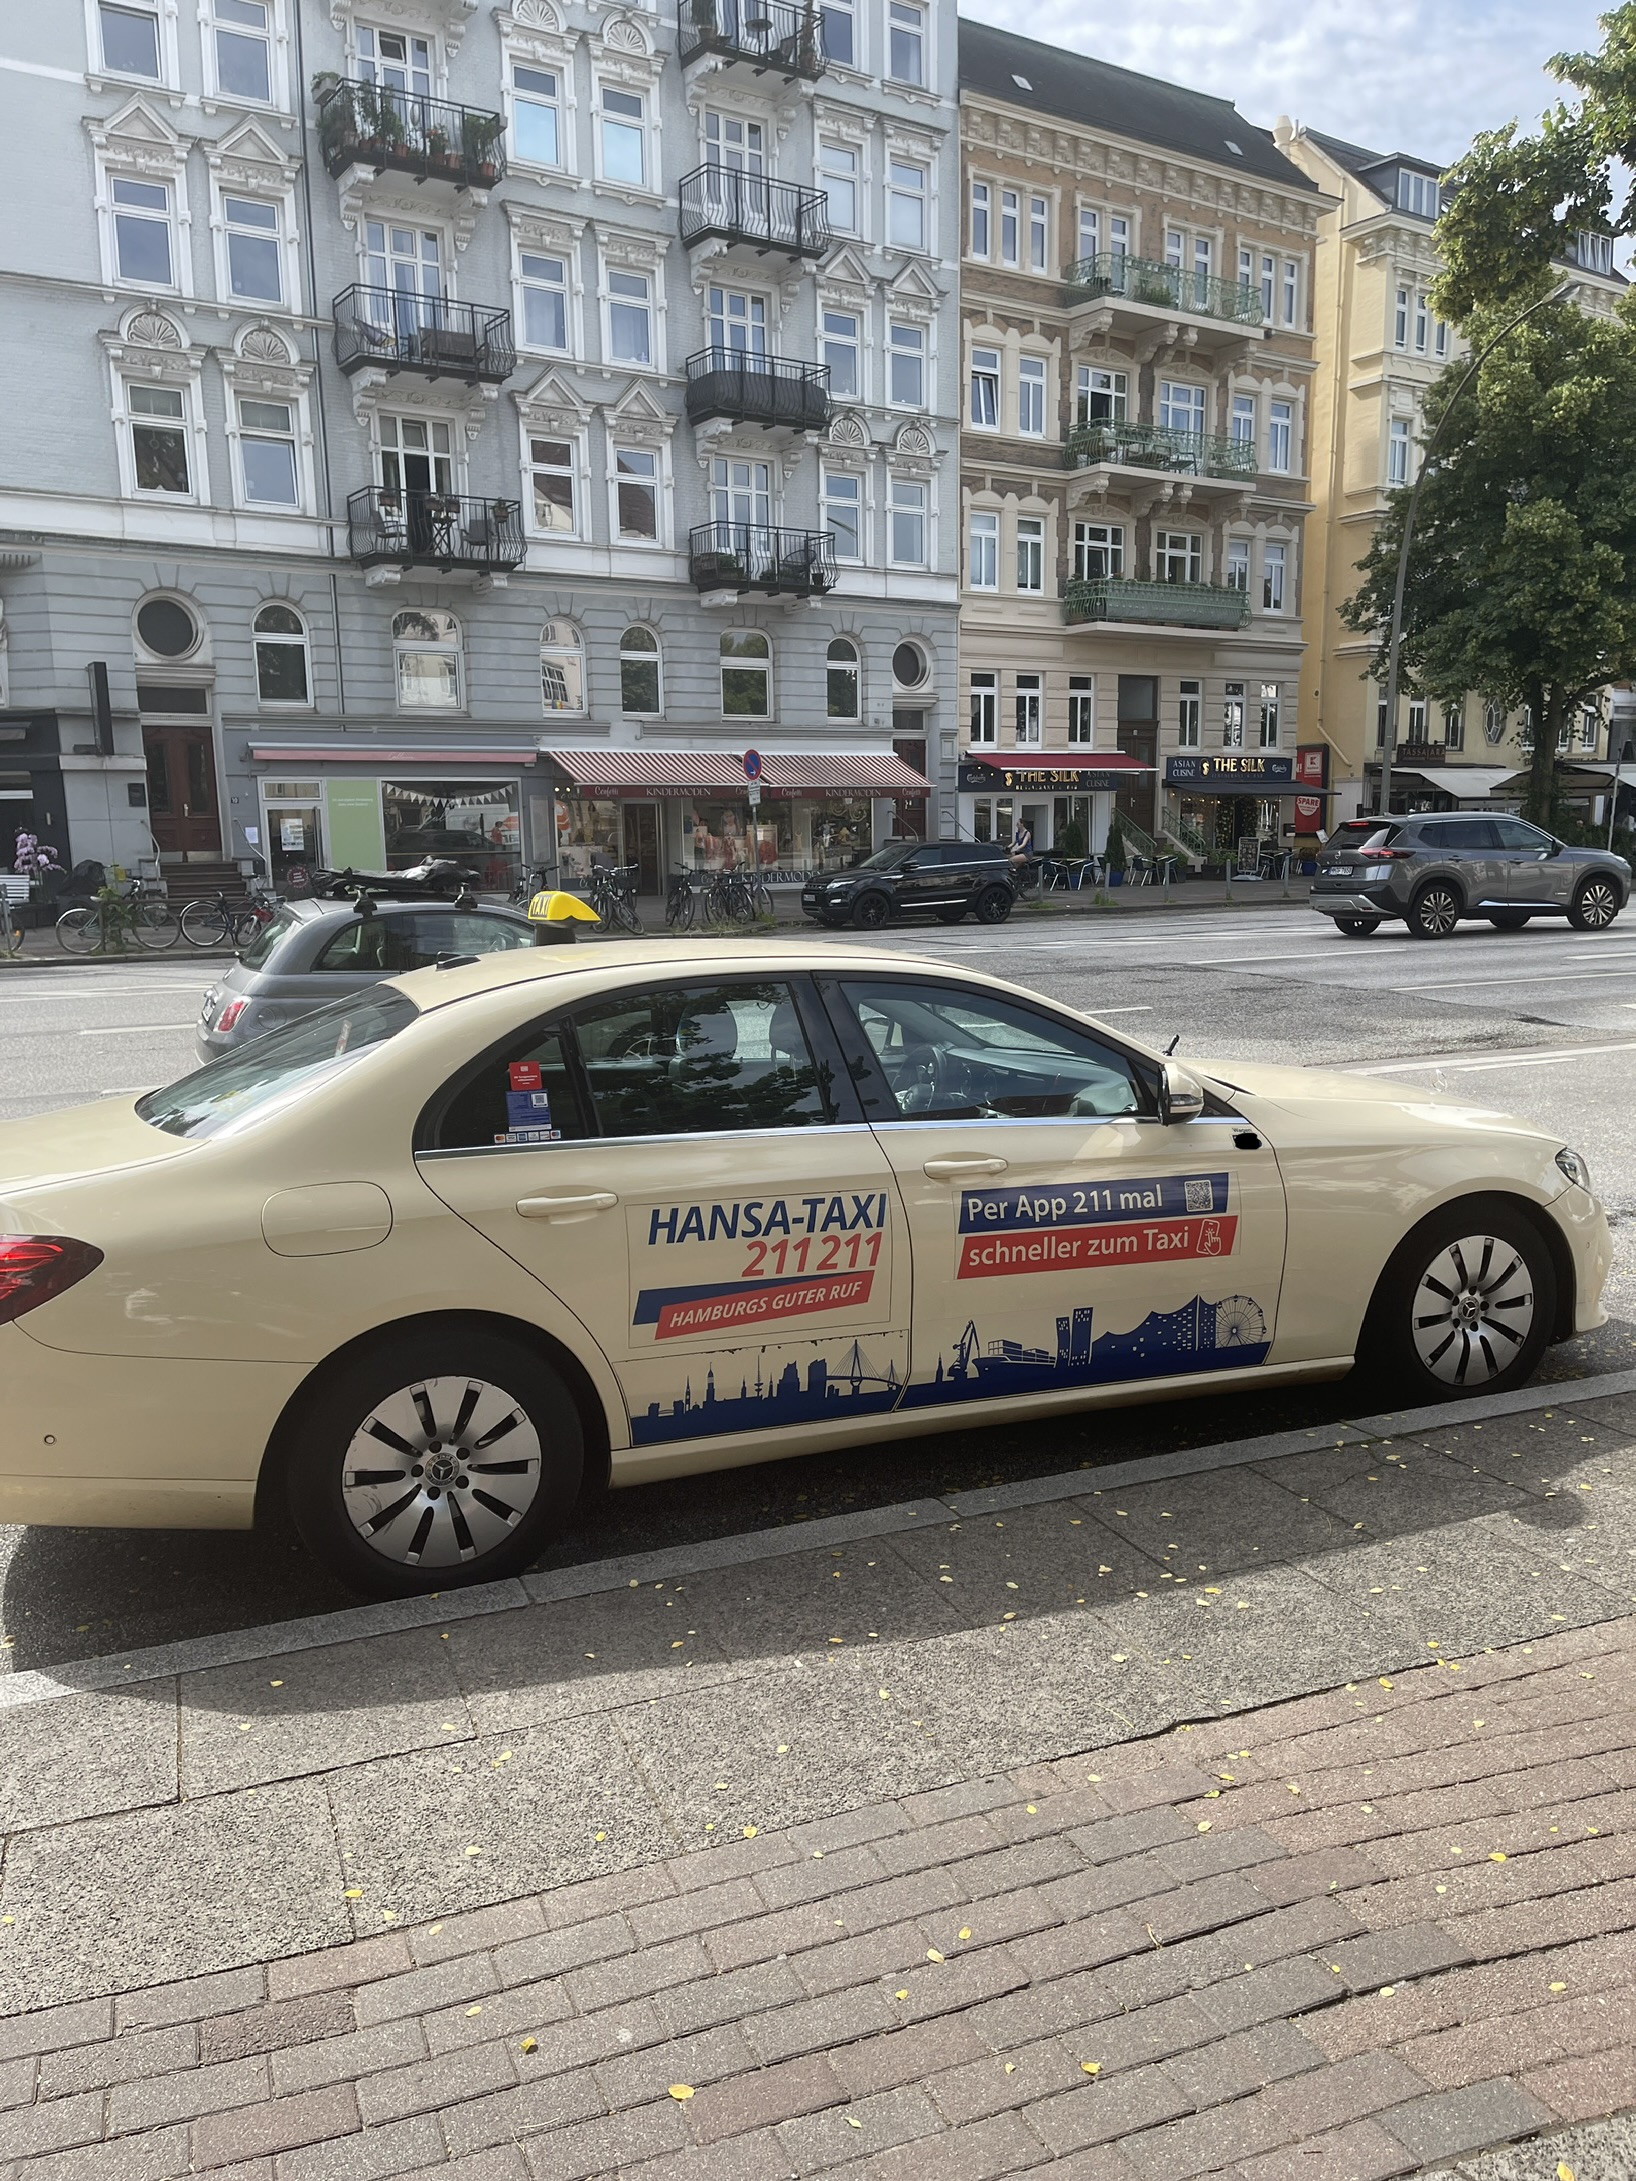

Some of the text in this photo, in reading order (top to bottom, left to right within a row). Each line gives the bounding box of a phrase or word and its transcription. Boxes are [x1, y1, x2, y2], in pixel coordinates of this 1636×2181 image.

[1172, 760, 1196, 768] ASIAN
[1213, 757, 1266, 773] THE SILK
[1019, 770, 1080, 783] THE SILK
[1172, 768, 1196, 777] CUISINE
[1086, 779, 1111, 788] CUISINE
[594, 786, 619, 797] Confetti
[646, 787, 712, 796] KINDERMODEN
[781, 787, 921, 798] Confetti KINDERMODEN Confetti
[1297, 796, 1320, 808] SPARE
[532, 896, 551, 916] TAXI
[968, 1183, 1163, 1222] Per App 211 mal
[648, 1193, 887, 1245] HANSA-TAXI
[968, 1226, 1189, 1267] schneller zum Taxi
[741, 1231, 883, 1278] 211 211
[669, 1280, 863, 1328] HAMBURGS GUTER RUF
